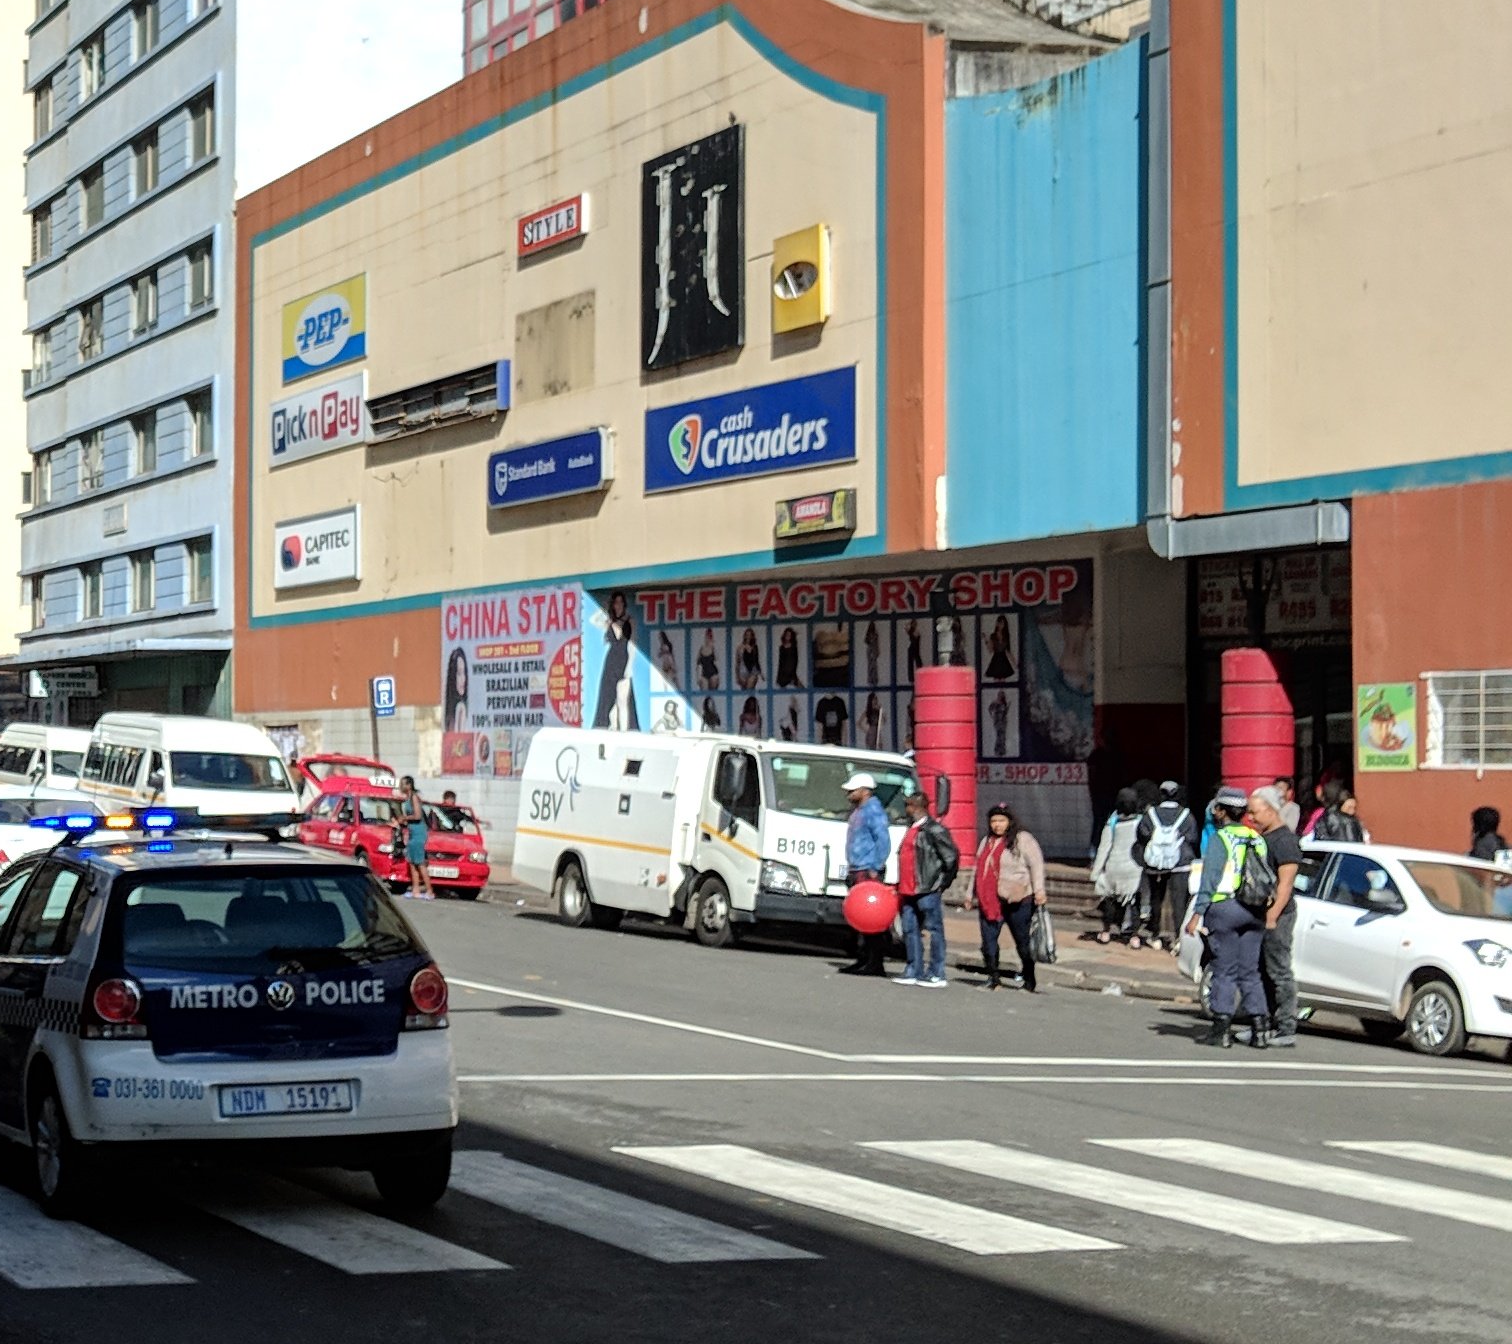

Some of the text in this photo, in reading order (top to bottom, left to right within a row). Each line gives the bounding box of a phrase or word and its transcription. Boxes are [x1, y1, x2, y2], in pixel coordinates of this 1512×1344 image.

[522, 206, 575, 247] STYLE
[299, 307, 344, 354] PEP
[271, 390, 361, 456] Pick n Pay
[719, 404, 755, 435] cash
[699, 412, 829, 470] Crusaders
[507, 460, 538, 482] Standard
[537, 456, 556, 476] Bank
[304, 529, 350, 554] CAPITEC
[306, 556, 321, 566] BANK
[637, 566, 1078, 624] THE FACTORY SHOP
[445, 590, 578, 641] CHINA STAR
[472, 659, 546, 676] WHOLESALE & RETAIL
[563, 643, 579, 678] R5
[380, 691, 389, 704] R
[486, 677, 529, 693] BRAZILIAN
[486, 696, 528, 710] PERUVIAN
[472, 712, 544, 728] 100% HUMAN HAIR
[1005, 765, 1049, 780] SHOP
[529, 789, 565, 822] SBV
[170, 979, 386, 1009] METRO POLICE
[114, 1079, 205, 1101] 031-361 0000
[286, 1085, 342, 1110] 15191
